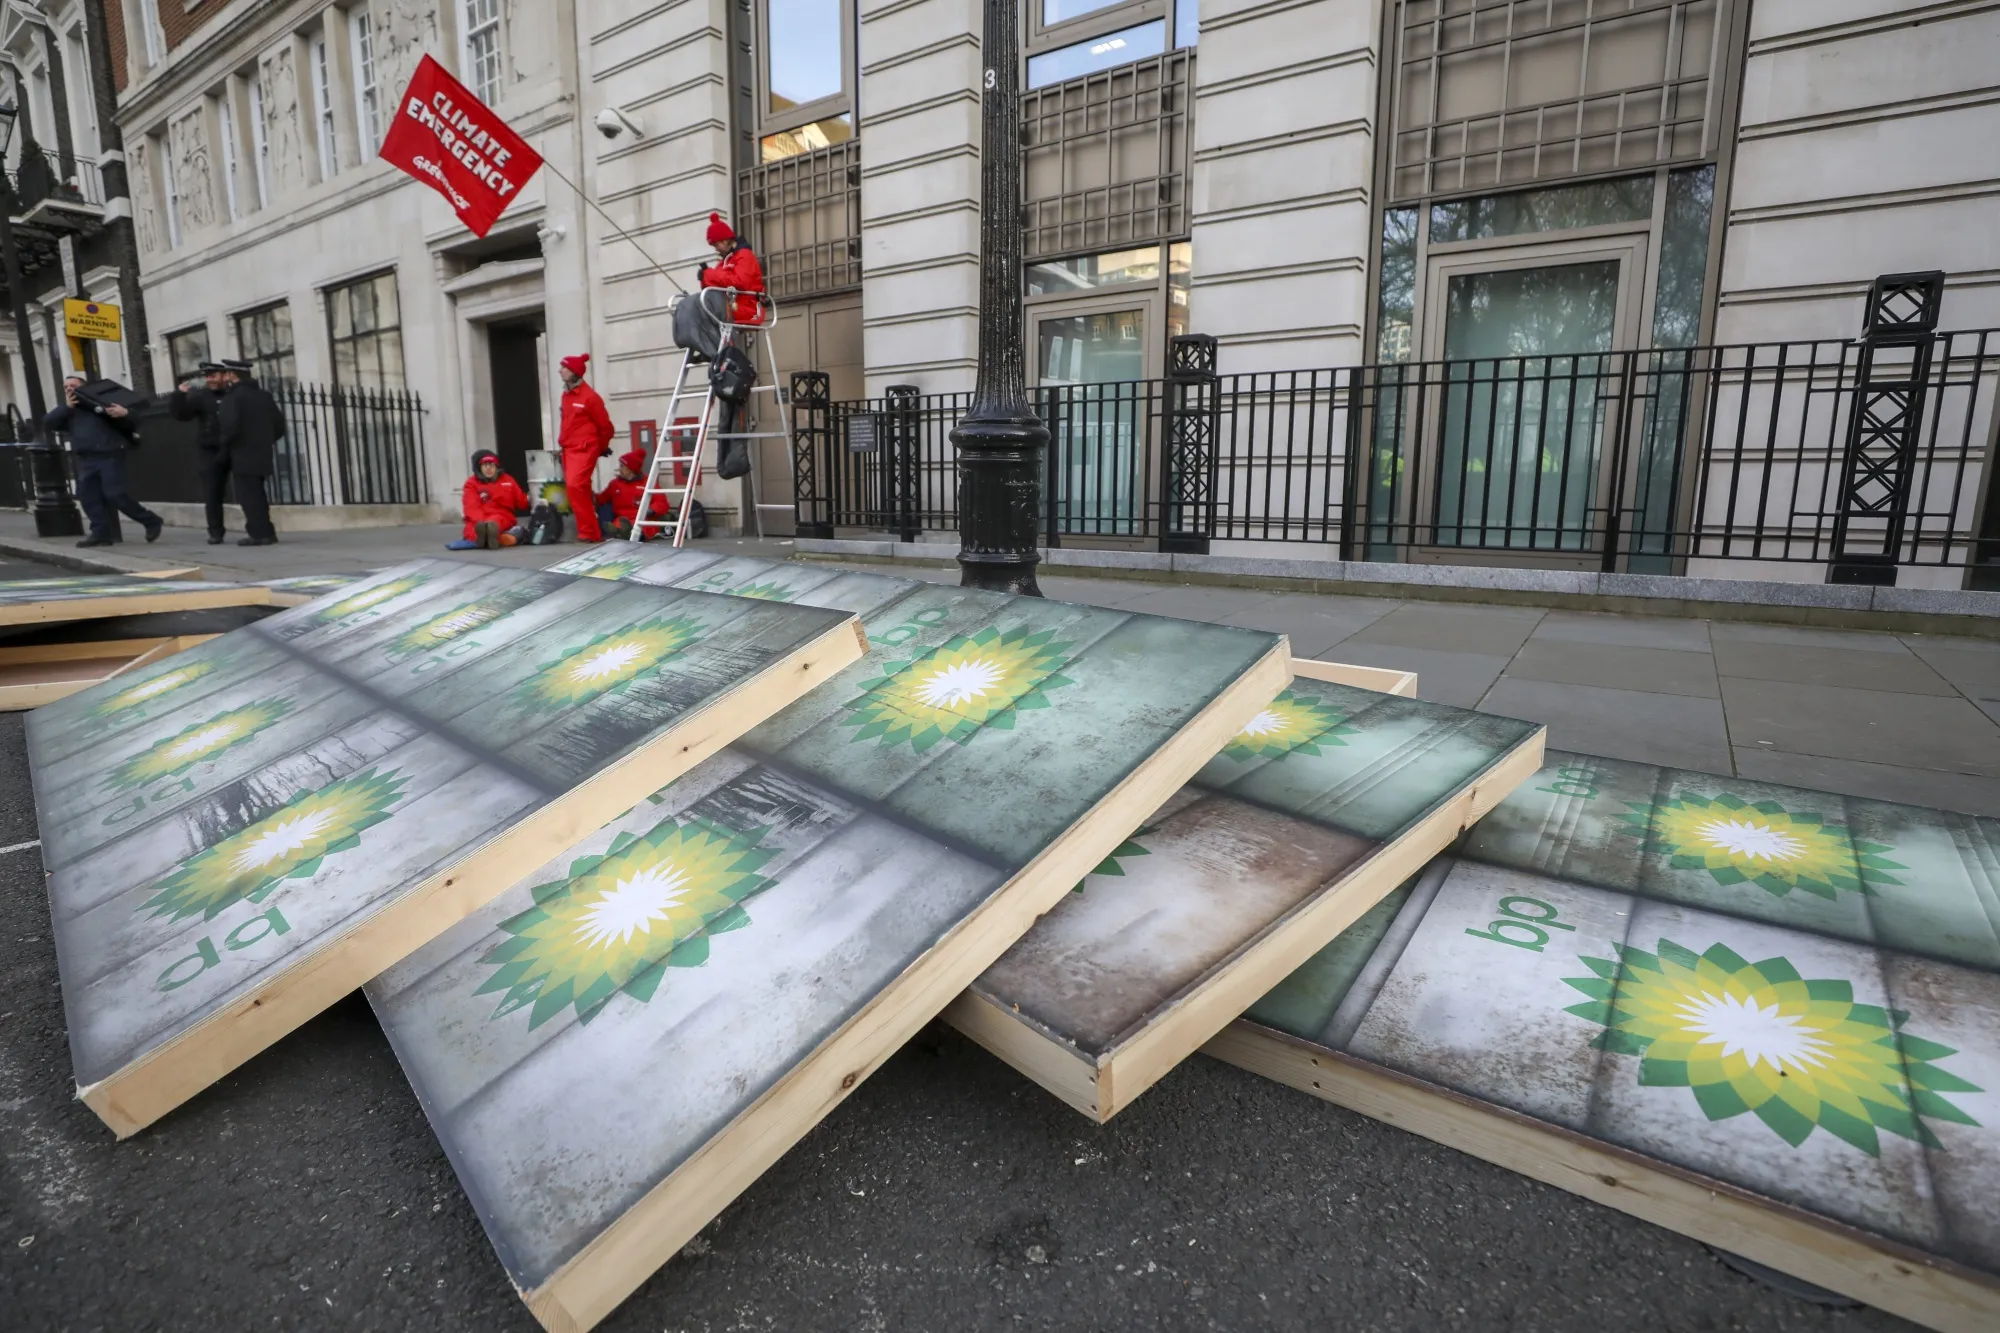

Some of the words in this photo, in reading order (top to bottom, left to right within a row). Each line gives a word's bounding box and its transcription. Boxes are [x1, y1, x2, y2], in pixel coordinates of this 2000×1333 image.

[985, 69, 995, 88] 3
[406, 96, 515, 197] EMERGENCY
[432, 91, 512, 168] CLIMATE
[69, 317, 116, 329] WARNING
[867, 605, 949, 647] bp
[102, 776, 196, 826] bp
[155, 905, 291, 992] bp
[1464, 896, 1577, 953] bp
